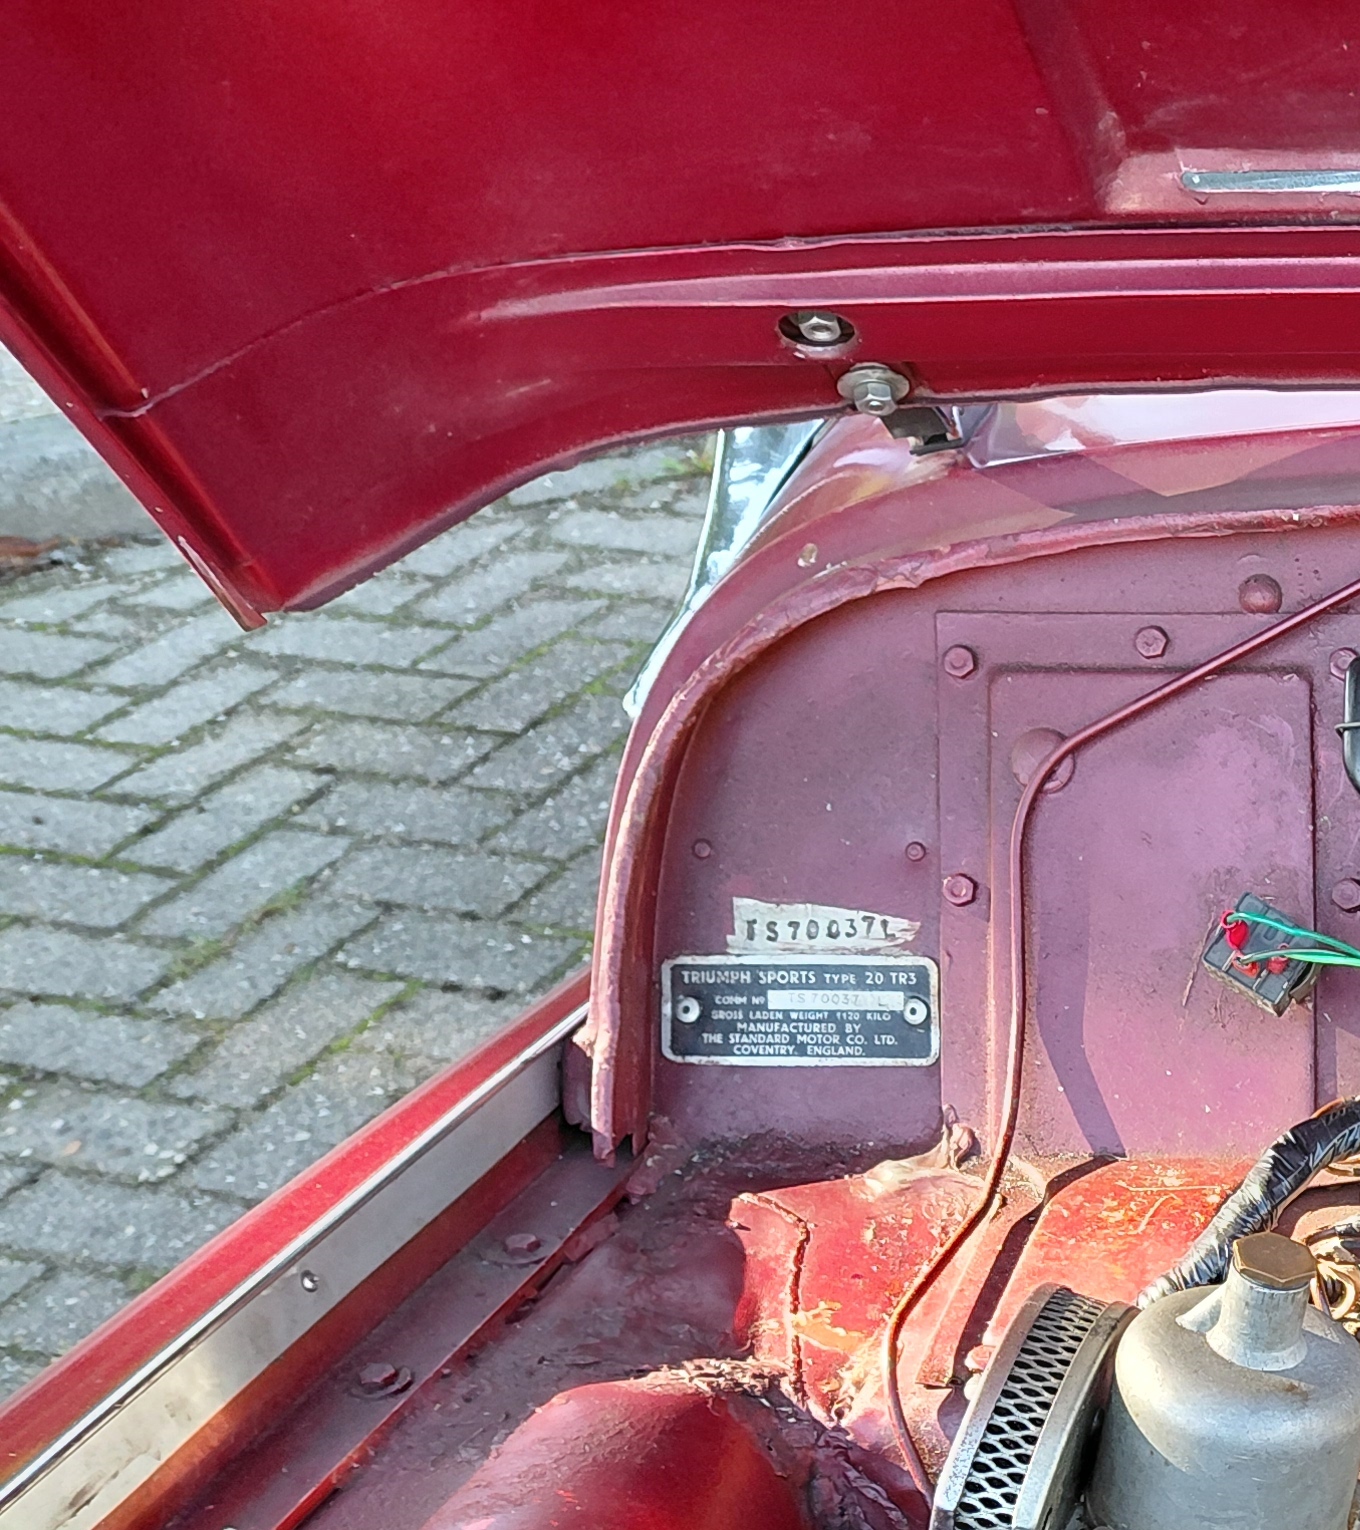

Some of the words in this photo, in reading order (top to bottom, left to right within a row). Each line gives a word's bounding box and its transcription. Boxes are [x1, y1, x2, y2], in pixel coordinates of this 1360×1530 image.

[681, 970, 752, 985] TRIUMPH
[758, 970, 816, 985] SPORTS
[823, 973, 857, 984] TYPE
[865, 971, 884, 985] 20
[889, 971, 917, 985] TR3
[710, 1009, 744, 1020] GROSS
[749, 1010, 784, 1020] LADEN
[789, 1011, 829, 1020] WEIGHT
[836, 1011, 860, 1020] 1120
[865, 1011, 891, 1021] KILO
[736, 1022, 837, 1033] MANUFACTURED
[844, 1023, 862, 1033] BY
[701, 1033, 724, 1044] THE
[728, 1033, 790, 1044] STANDARD
[796, 1034, 841, 1045] MOTOR
[846, 1035, 868, 1045] CO.
[873, 1034, 898, 1045] LTD.
[806, 1045, 866, 1056] ENGLAND.
